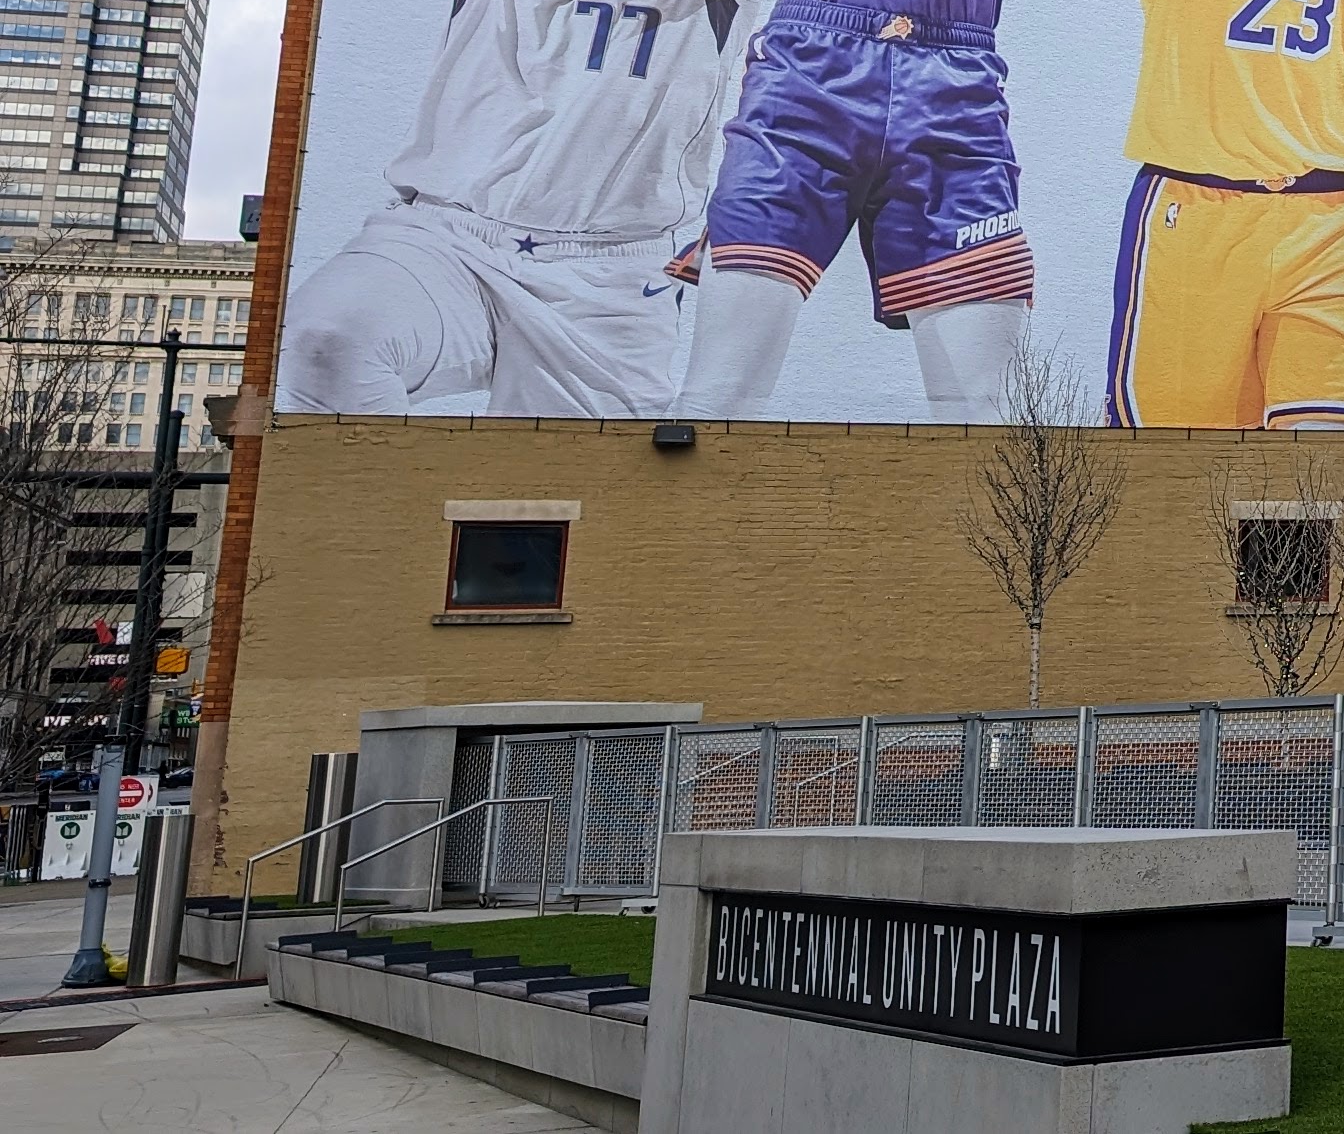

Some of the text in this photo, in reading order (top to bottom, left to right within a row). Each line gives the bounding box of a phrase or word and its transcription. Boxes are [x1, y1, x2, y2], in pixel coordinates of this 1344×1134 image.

[575, 0, 662, 80] 77
[55, 813, 88, 822] MERIDIAN
[716, 905, 1061, 1034] BICENTENNIAL UNITY PLAZA
